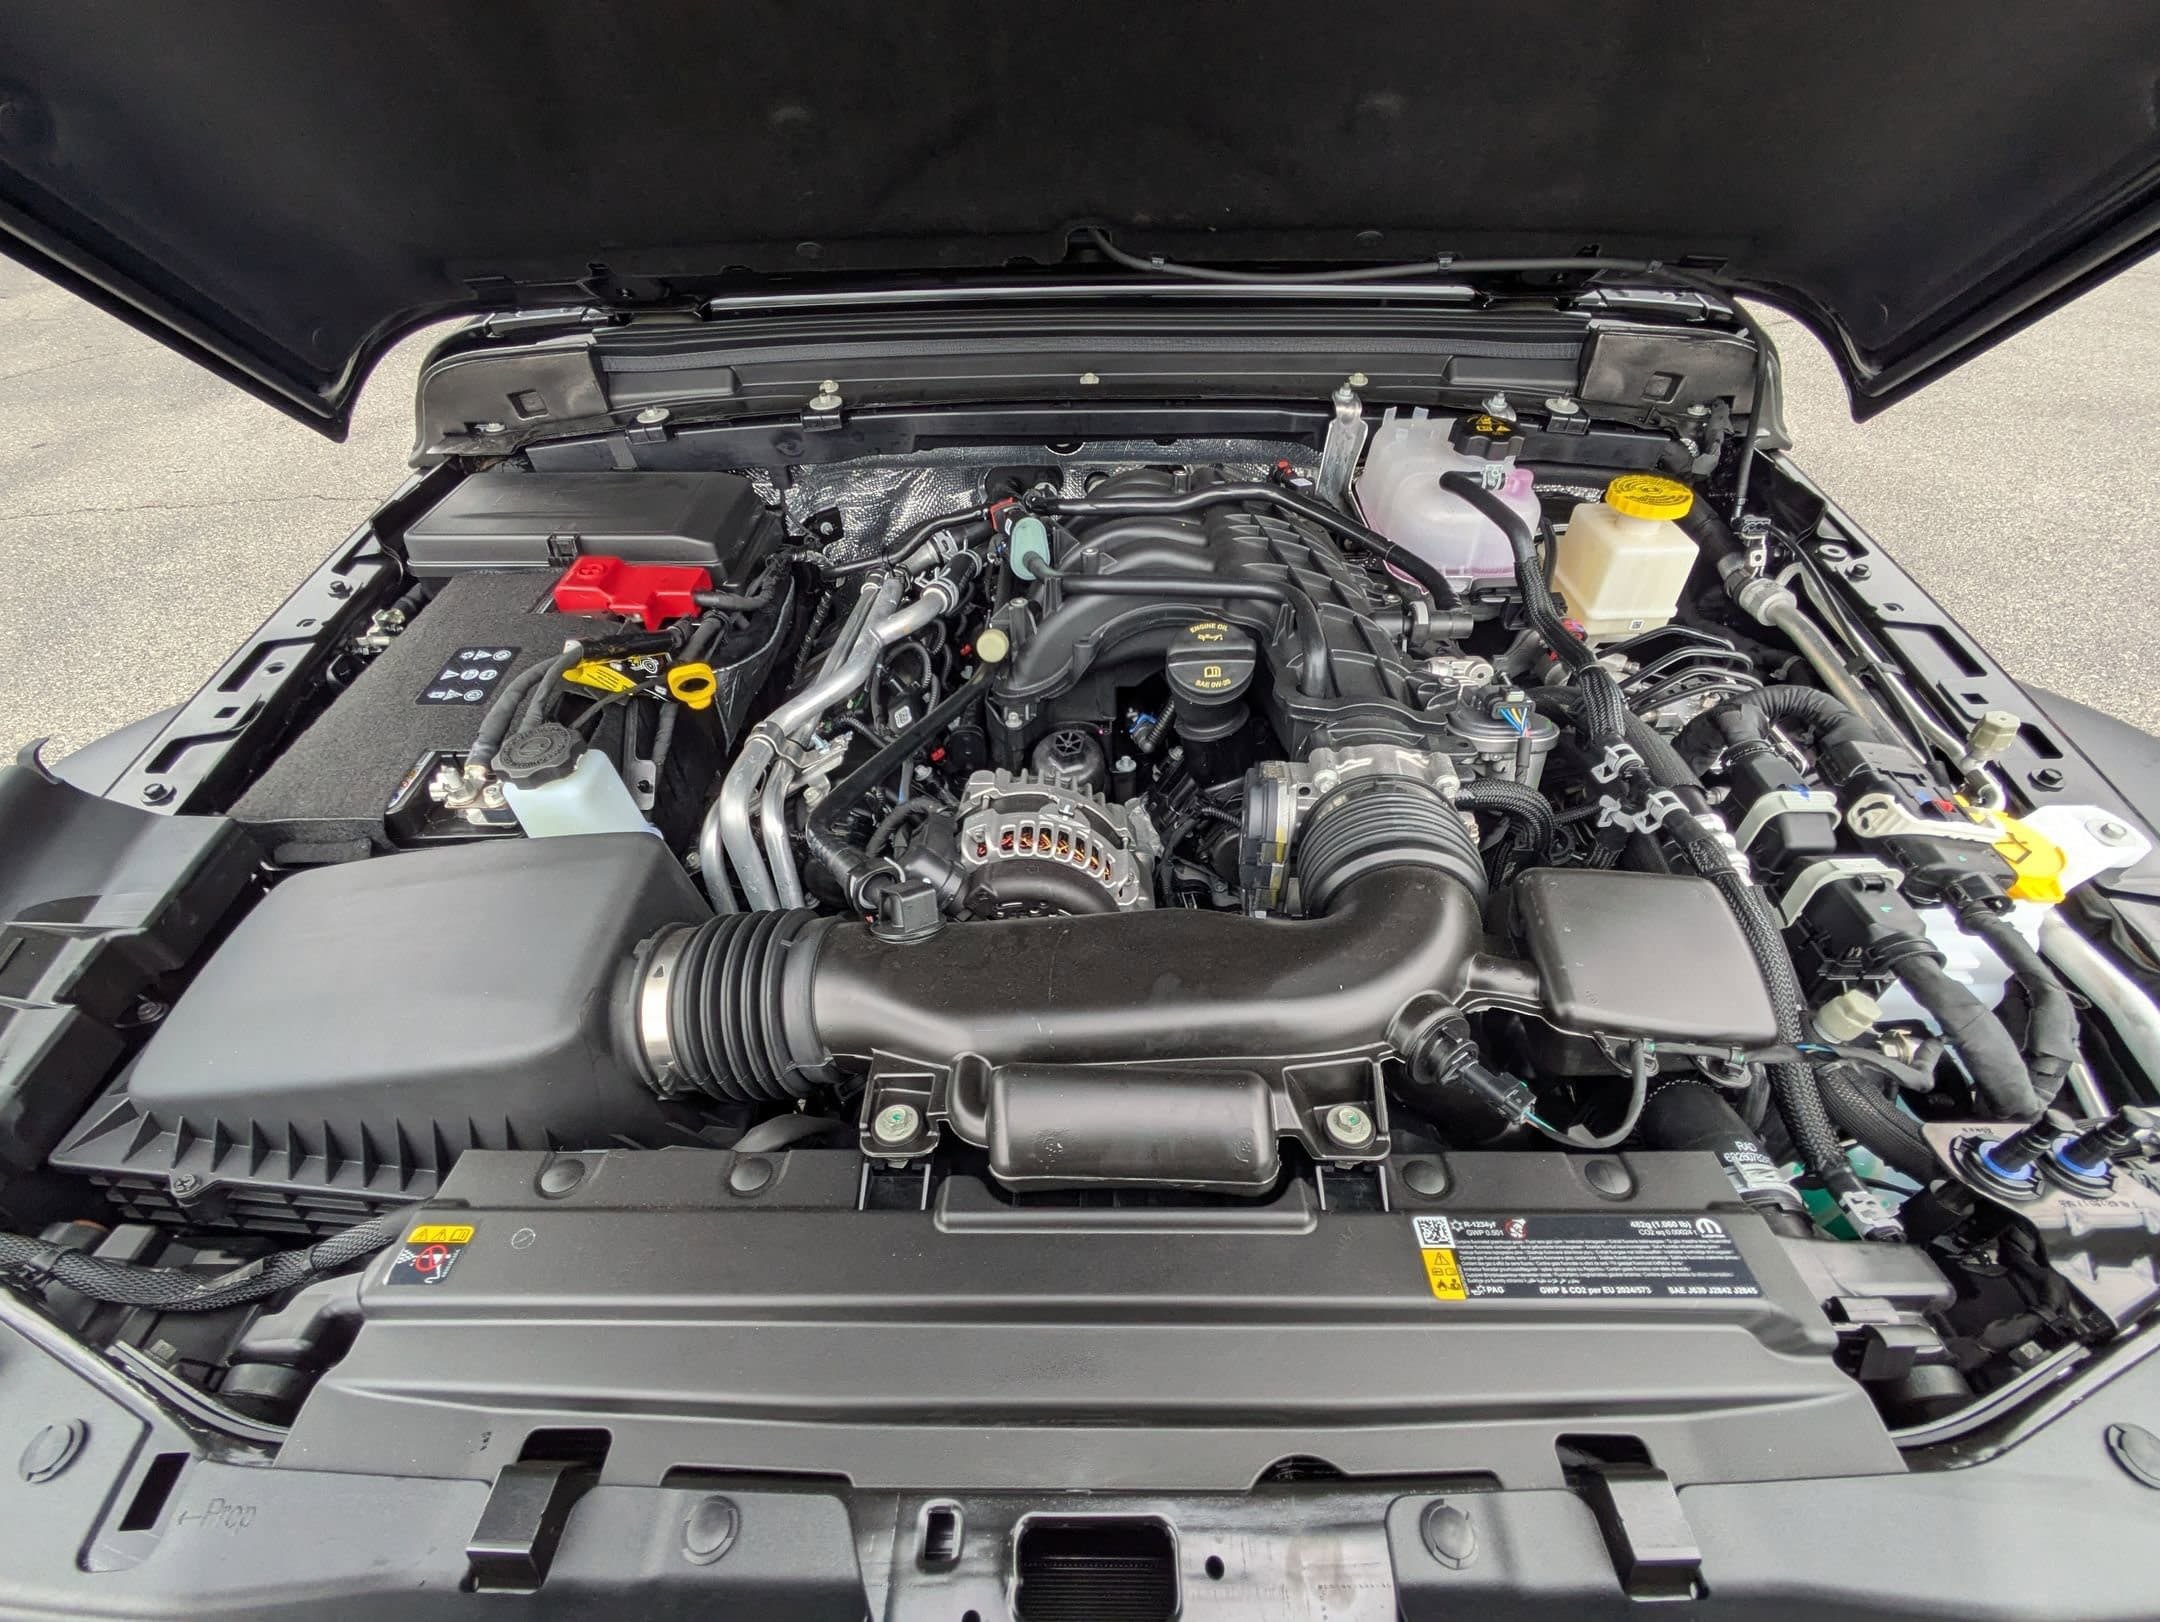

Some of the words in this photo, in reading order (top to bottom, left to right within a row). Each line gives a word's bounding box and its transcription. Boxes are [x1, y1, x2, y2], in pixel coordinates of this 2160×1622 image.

[1189, 623, 1217, 634] ENGINE
[1217, 623, 1229, 632] OIL
[1195, 679, 1210, 689] SAE
[1487, 1286, 1505, 1294] PAG
